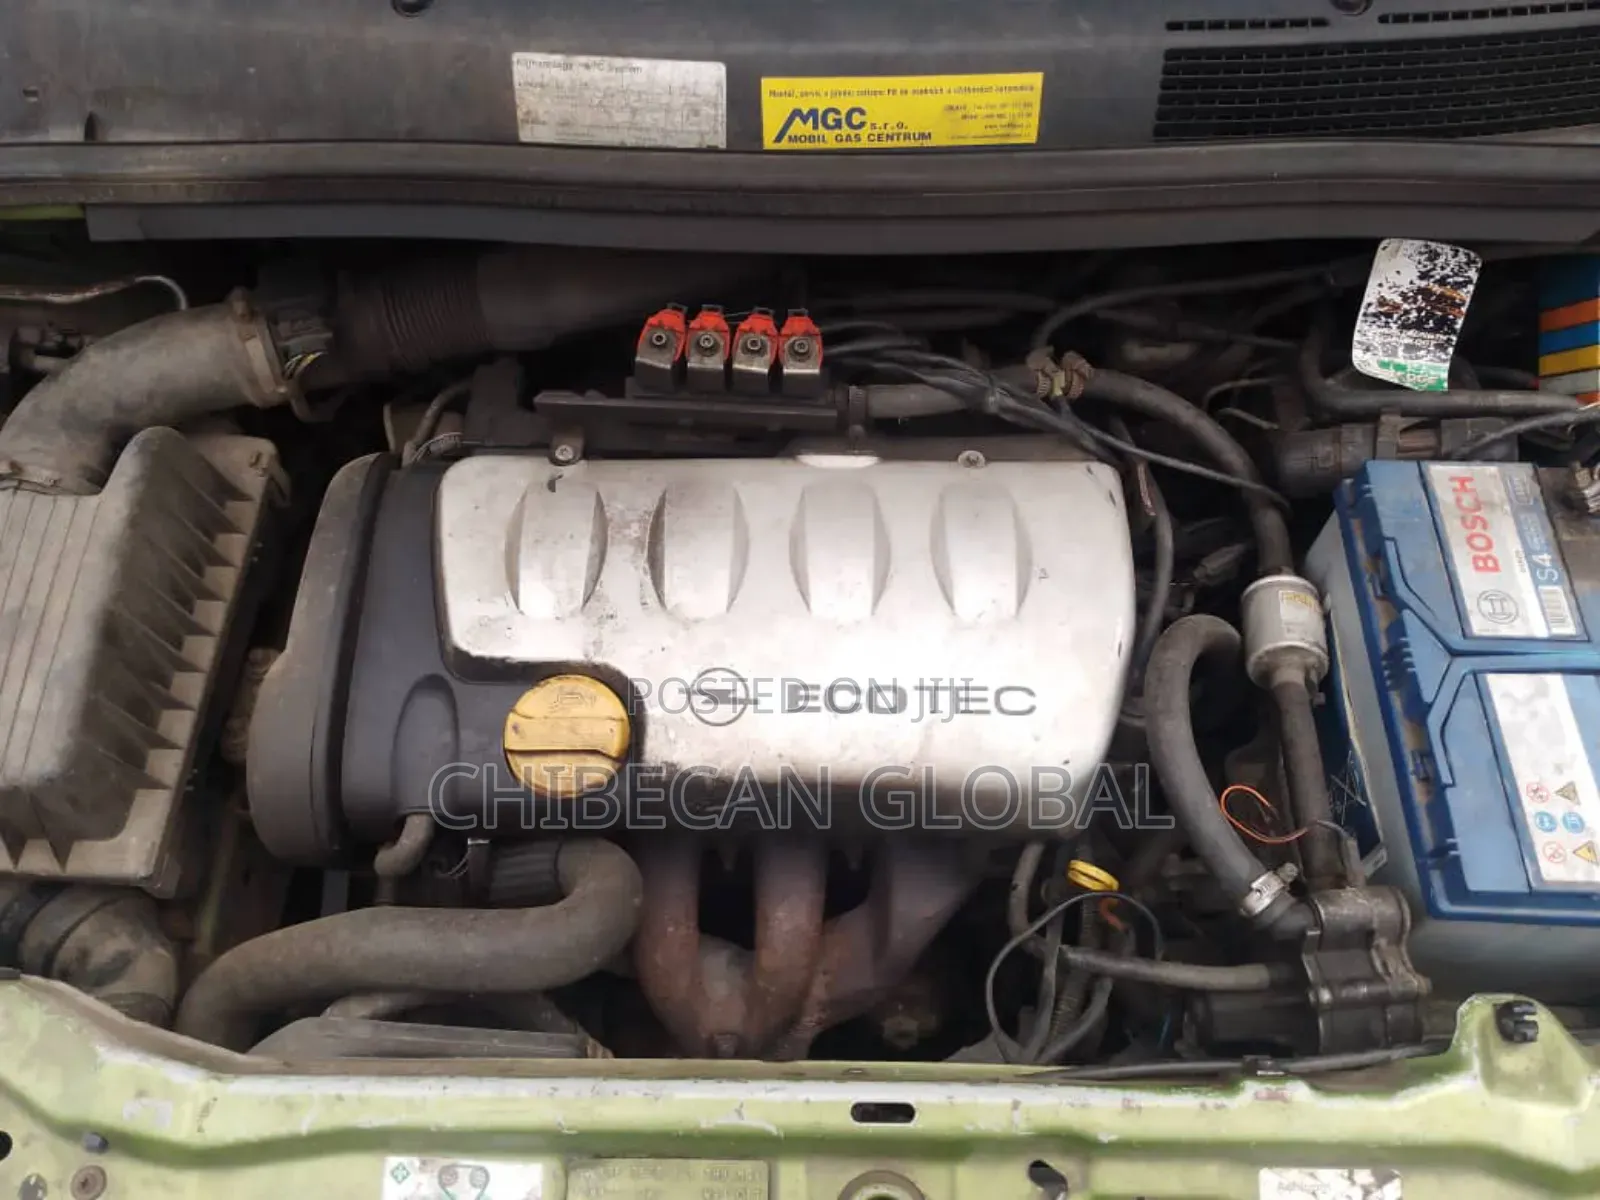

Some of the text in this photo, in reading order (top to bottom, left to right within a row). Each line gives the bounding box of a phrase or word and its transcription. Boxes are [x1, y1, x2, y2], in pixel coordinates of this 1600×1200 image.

[773, 106, 867, 144] MGC
[787, 131, 932, 144] MOBIL GAS CENTRUM
[1448, 475, 1502, 574] BOSCH
[1531, 552, 1559, 582] S4
[788, 684, 1036, 716] ECOTEC
